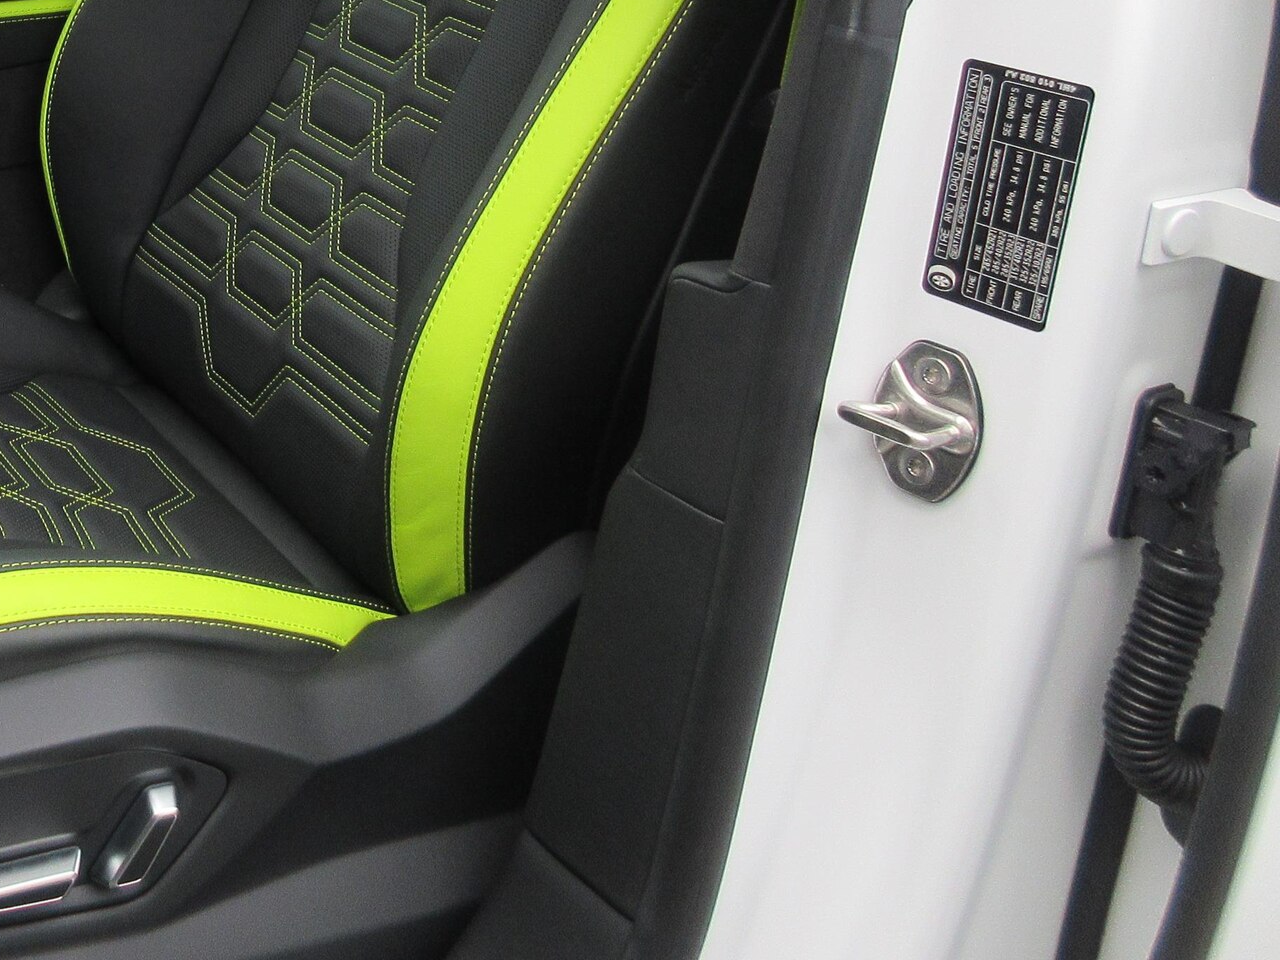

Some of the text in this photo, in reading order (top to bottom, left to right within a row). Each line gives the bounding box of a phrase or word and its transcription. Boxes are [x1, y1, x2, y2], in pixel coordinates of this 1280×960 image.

[1038, 78, 1055, 88] 010
[1002, 87, 1020, 137] SEE OWNER'S
[1018, 93, 1035, 139] MANUAL FOR
[1034, 99, 1051, 143] ADDITIONAL
[1050, 99, 1068, 148] INFORMATION
[937, 73, 979, 253] TIRE AND LOADING INFORMATION
[950, 226, 962, 258] SEATING
[966, 154, 977, 175] TOTAL
[973, 117, 983, 140] FRONT
[980, 85, 990, 105] REAR
[982, 148, 1001, 217] COLD TIRE PRESSURE
[1002, 208, 1012, 223] 240
[1009, 167, 1021, 185] 34.8
[1015, 150, 1024, 165] psi
[1029, 217, 1039, 232] 240
[1036, 175, 1048, 193] 34.8
[1042, 159, 1051, 173] psi
[973, 244, 982, 261] SIZE
[991, 231, 1007, 274] 285/40ZR22
[1000, 234, 1016, 277] 285/35ZR23
[1019, 240, 1035, 283] 325/35ZR22
[966, 274, 977, 293] TIRE
[985, 279, 997, 305] FRONT
[1012, 290, 1023, 312] REAR
[1032, 295, 1045, 320] SPARE
